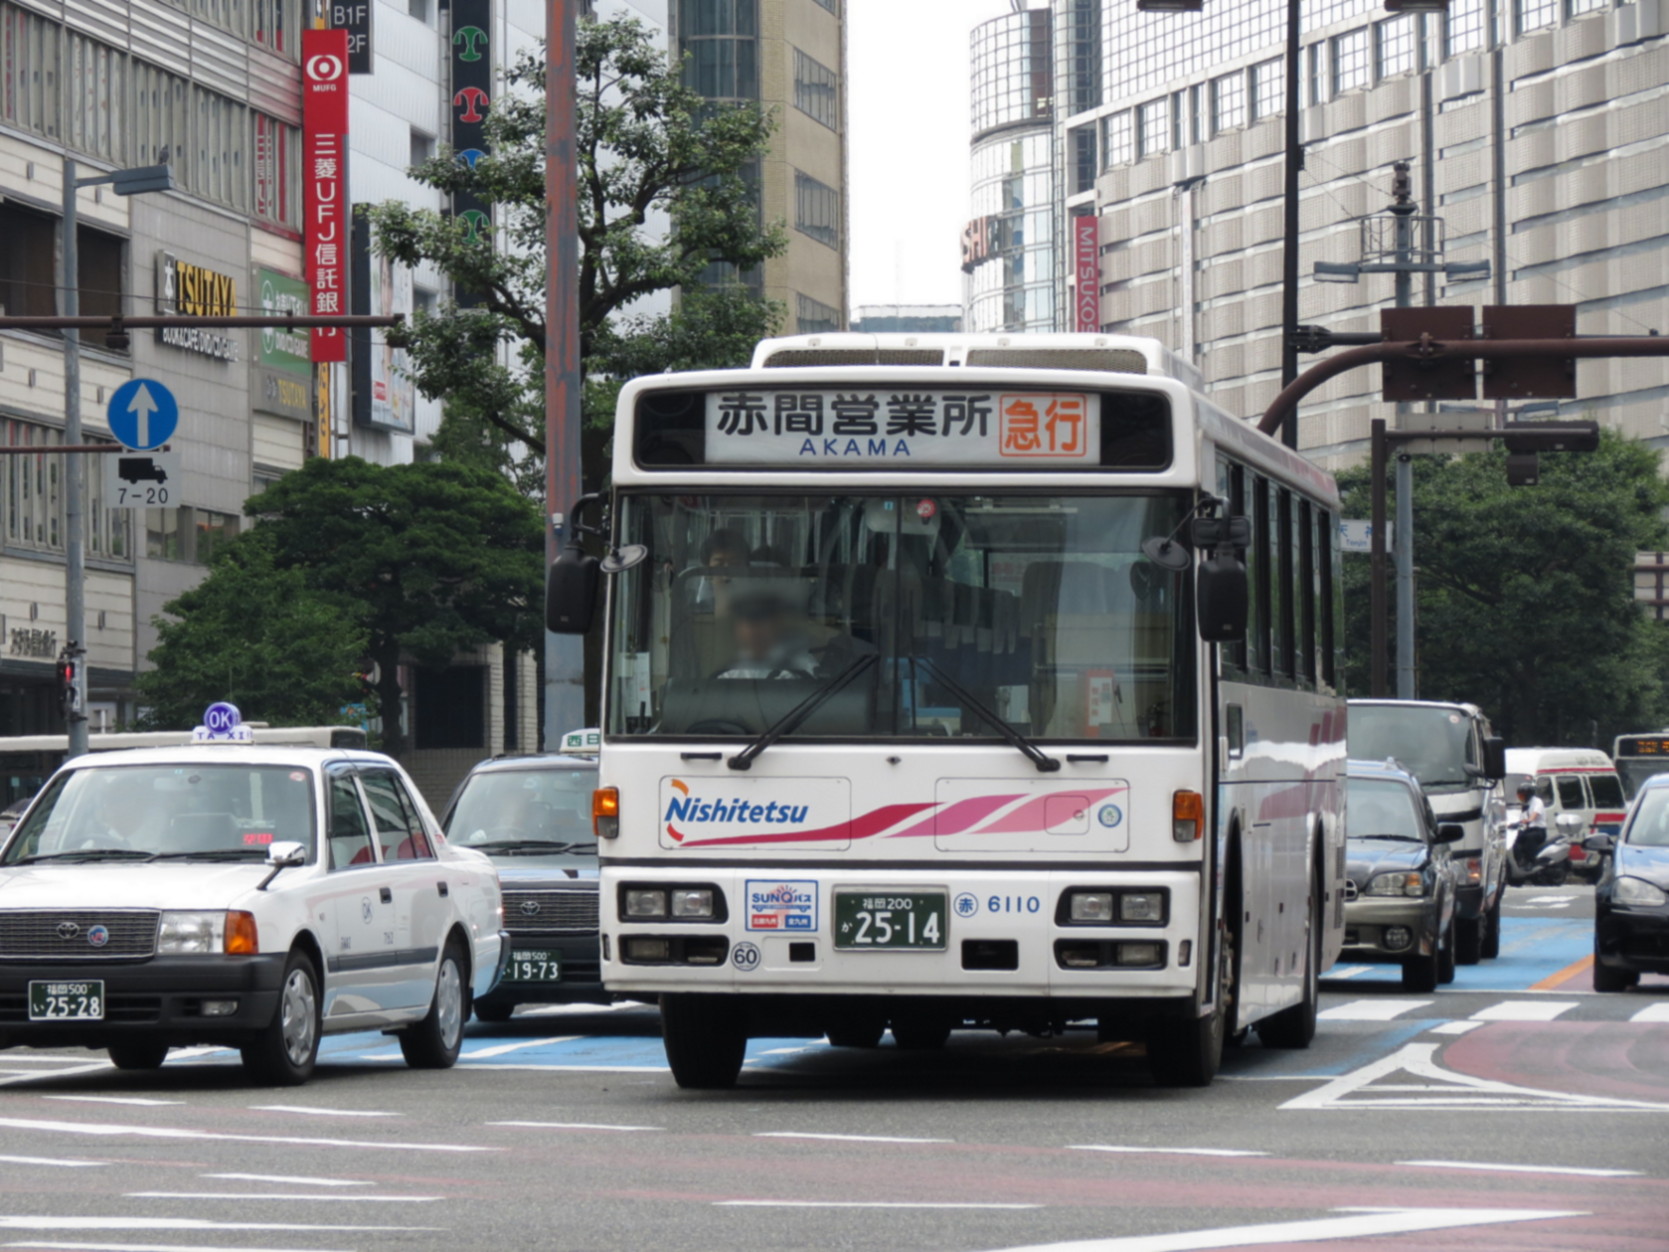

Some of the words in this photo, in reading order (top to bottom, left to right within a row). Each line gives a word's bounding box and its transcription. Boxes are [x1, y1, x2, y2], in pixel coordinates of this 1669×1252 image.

[334, 6, 366, 25] B1F
[313, 84, 336, 92] MUFG
[177, 261, 238, 317] TSUTAYA
[717, 394, 992, 437] 赤間営業所
[1004, 399, 1082, 452] 急行
[799, 438, 911, 456] AKAMA
[118, 487, 168, 504] 7-20
[209, 711, 232, 728] OK
[664, 797, 809, 823] Nishitetsu
[987, 896, 1040, 913] 6110
[855, 911, 940, 944] 25-14
[734, 948, 758, 964] 60
[513, 961, 559, 979] 19-73
[46, 996, 100, 1017] 25-28
